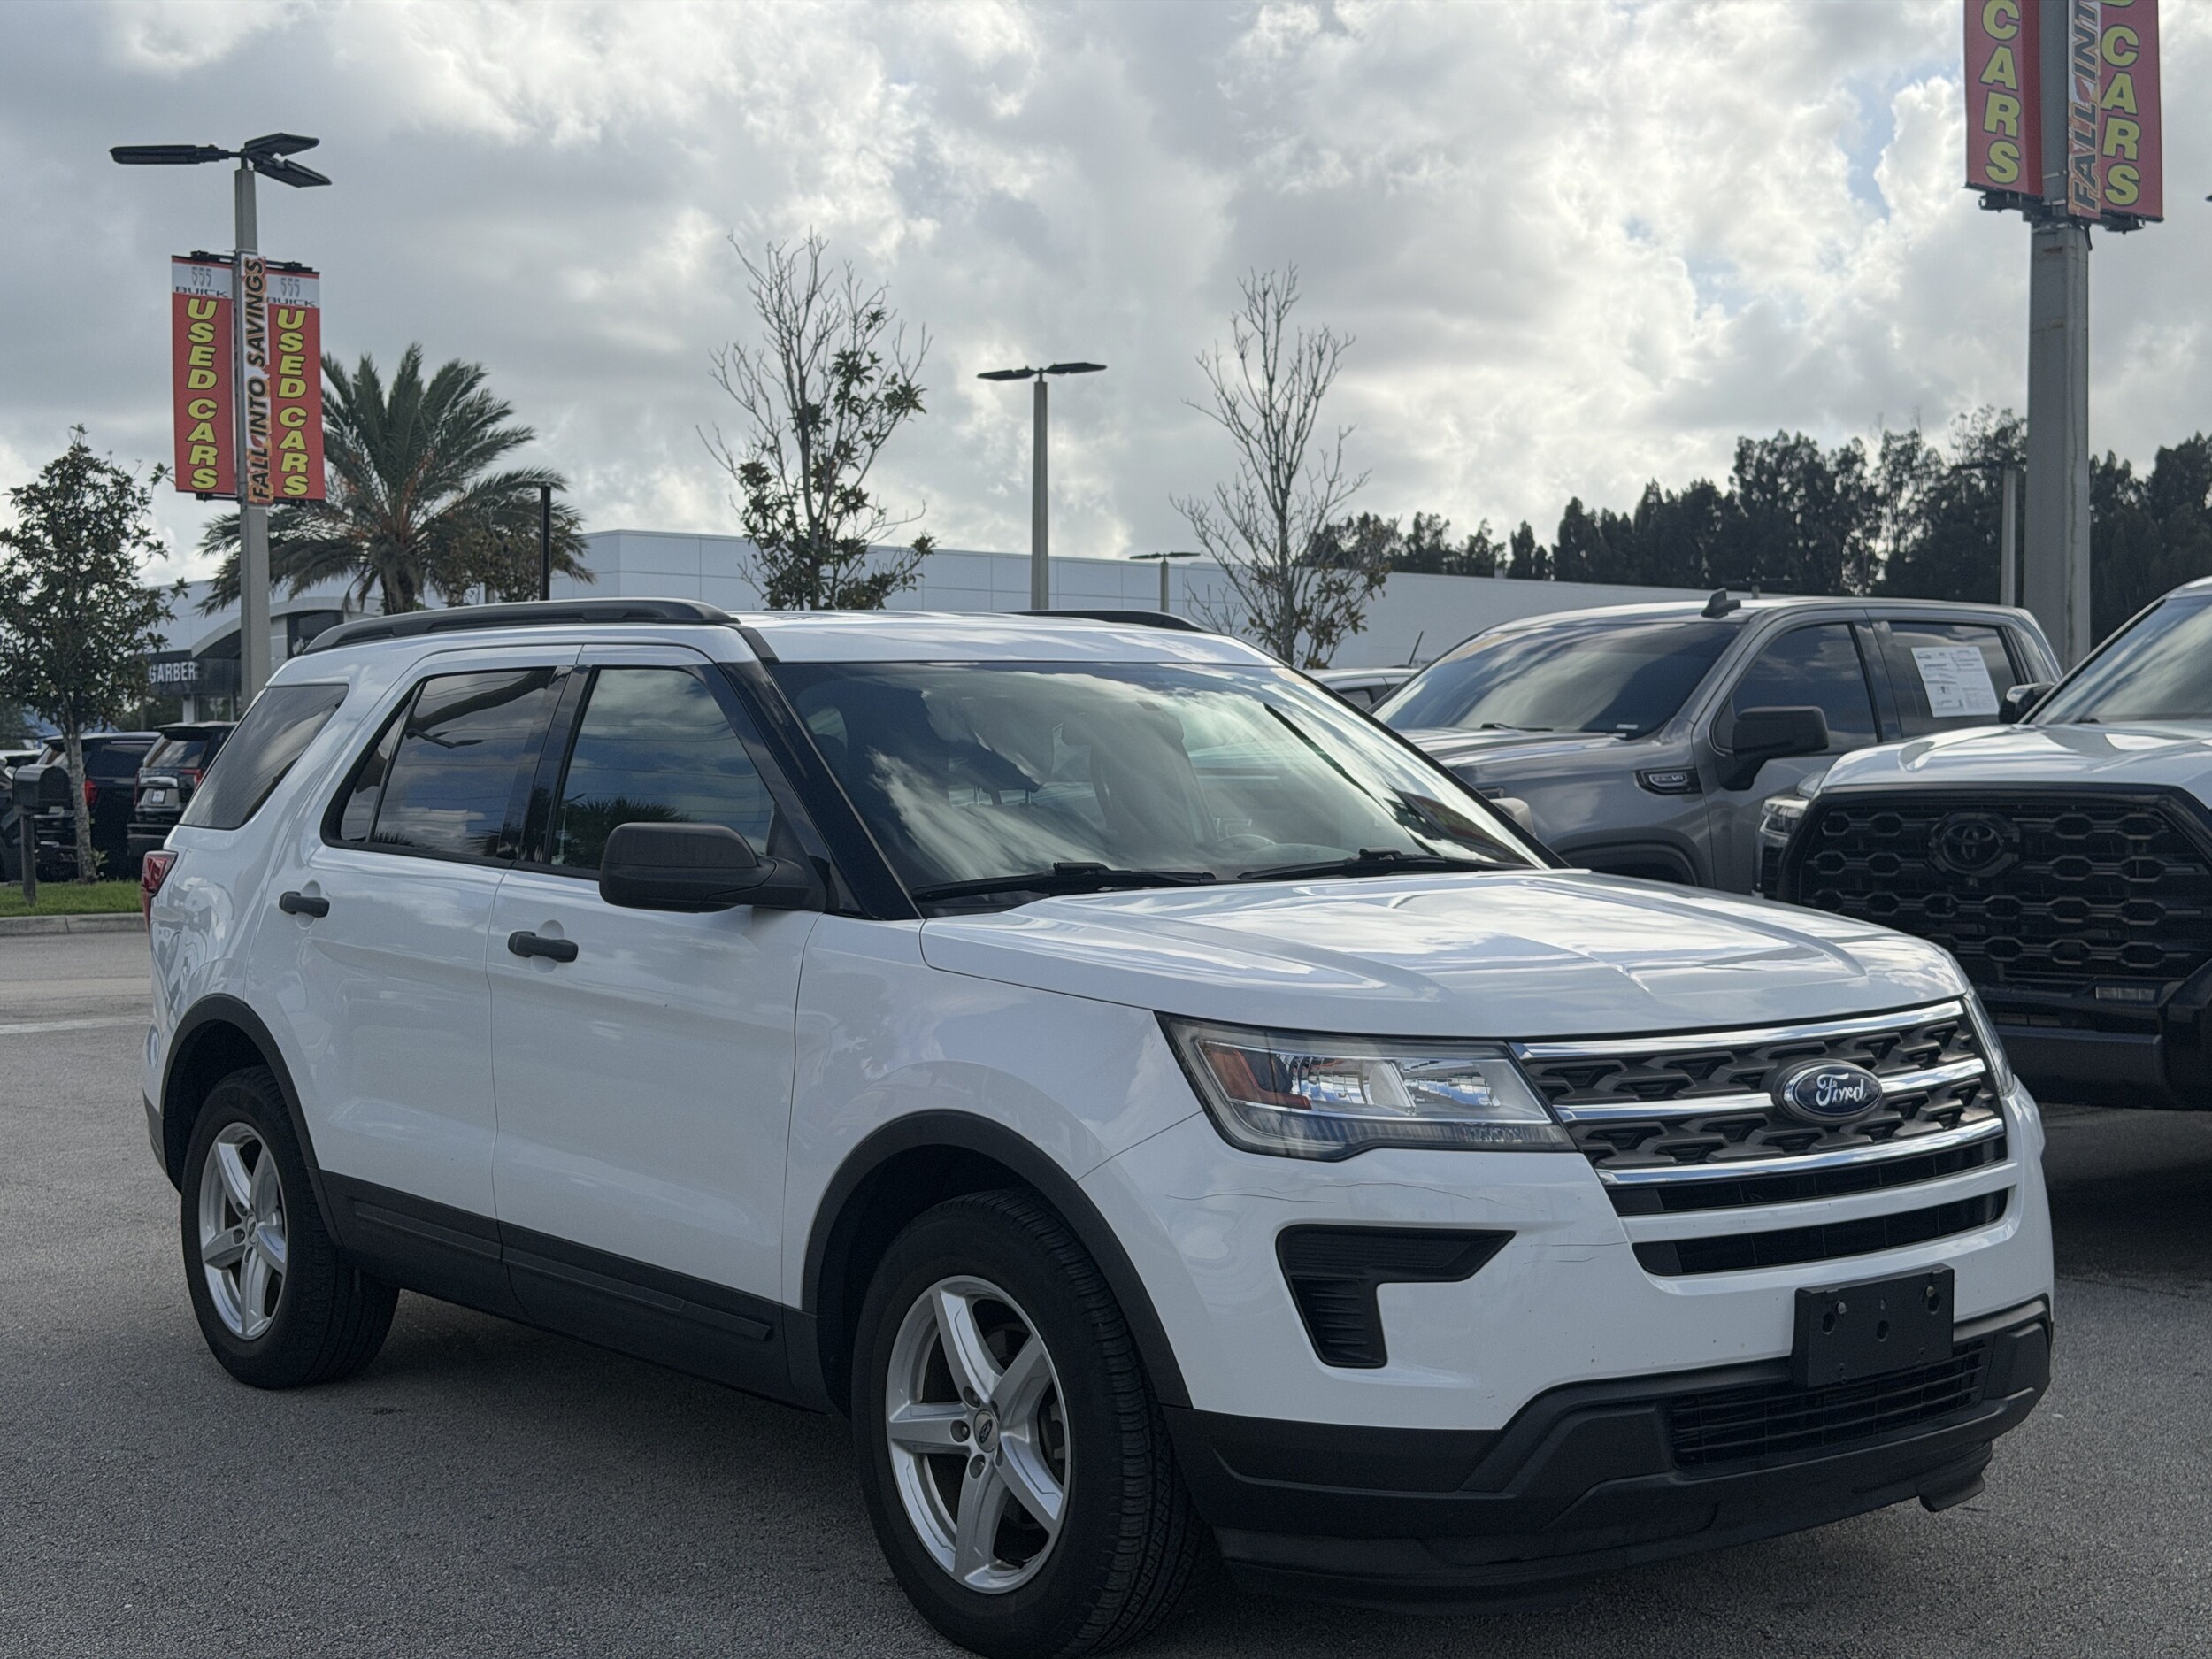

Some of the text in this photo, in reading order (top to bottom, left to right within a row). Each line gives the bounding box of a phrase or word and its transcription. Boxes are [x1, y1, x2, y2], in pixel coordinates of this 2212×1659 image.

[1979, 0, 2021, 184] CARS
[2072, 102, 2097, 212] FALL
[2101, 24, 2141, 206] CARS
[186, 298, 219, 490] USED CARS
[245, 259, 271, 500] FALL INTO SAVINGS
[276, 308, 309, 496] USED CARS
[149, 661, 197, 684] GARBER
[1816, 1072, 1867, 1107] Ford
